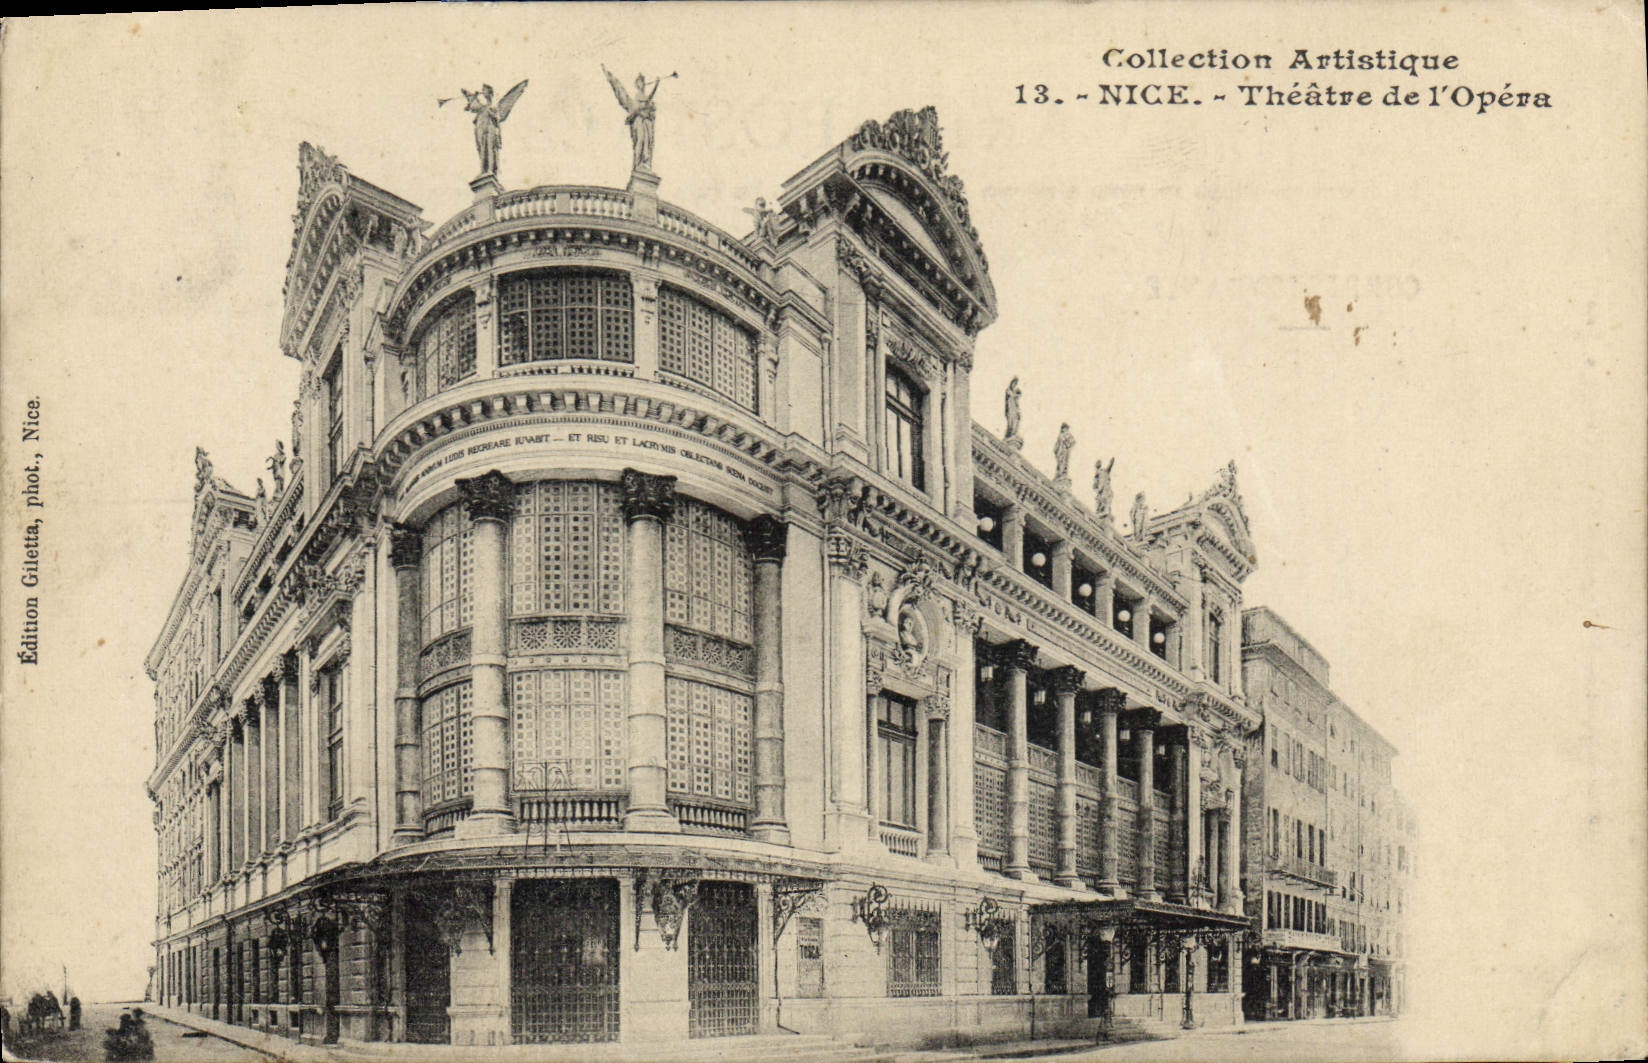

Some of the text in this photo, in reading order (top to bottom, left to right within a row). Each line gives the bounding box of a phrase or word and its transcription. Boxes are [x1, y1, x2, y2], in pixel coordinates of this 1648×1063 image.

[467, 438, 511, 455] RECREARE
[568, 433, 581, 442] ET
[587, 433, 609, 443] RISU
[615, 436, 629, 445] ET
[632, 438, 676, 454] LACRYMIS
